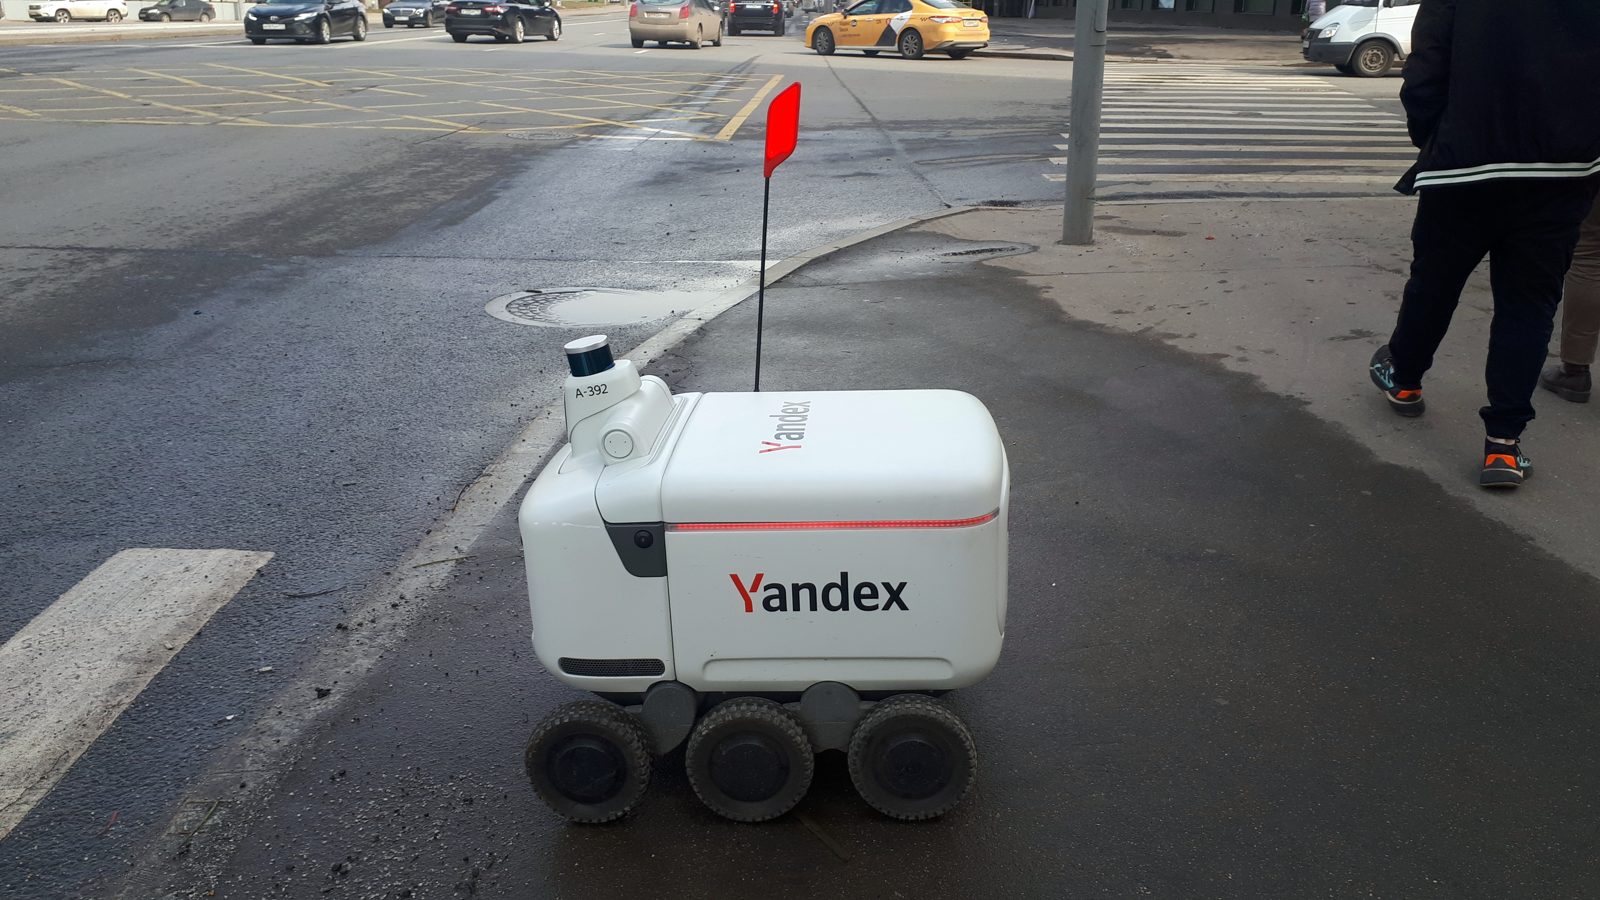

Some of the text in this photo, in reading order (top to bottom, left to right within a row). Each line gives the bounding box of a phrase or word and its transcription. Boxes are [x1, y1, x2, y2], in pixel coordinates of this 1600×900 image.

[575, 383, 609, 399] A-392
[758, 401, 811, 454] Yandex
[729, 571, 910, 614] Yandex
